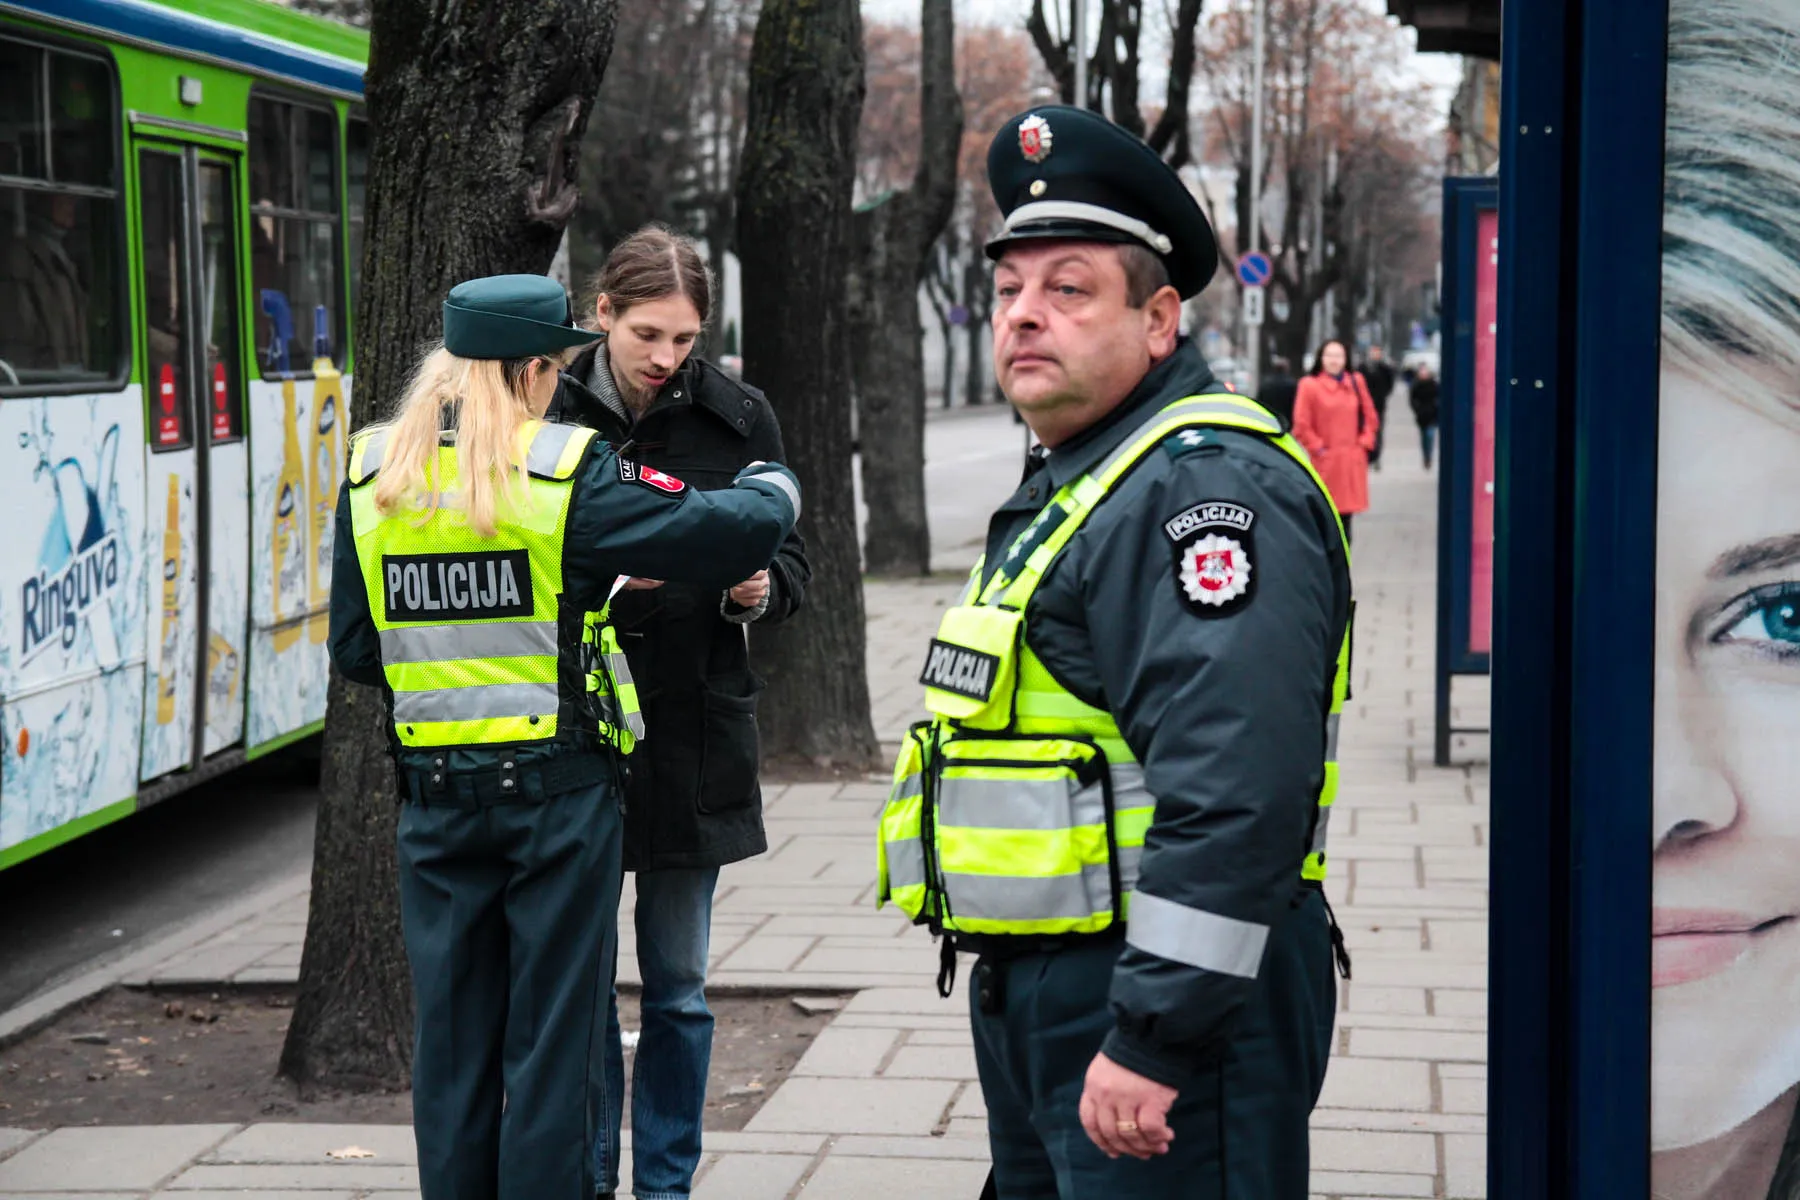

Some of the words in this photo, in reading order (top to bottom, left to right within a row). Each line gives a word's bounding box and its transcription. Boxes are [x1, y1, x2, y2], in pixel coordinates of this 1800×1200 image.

[1171, 506, 1246, 535] POLICIJA
[22, 537, 118, 654] Ringuva
[387, 559, 521, 610] POLICIJA
[924, 645, 991, 696] POLICIJA
